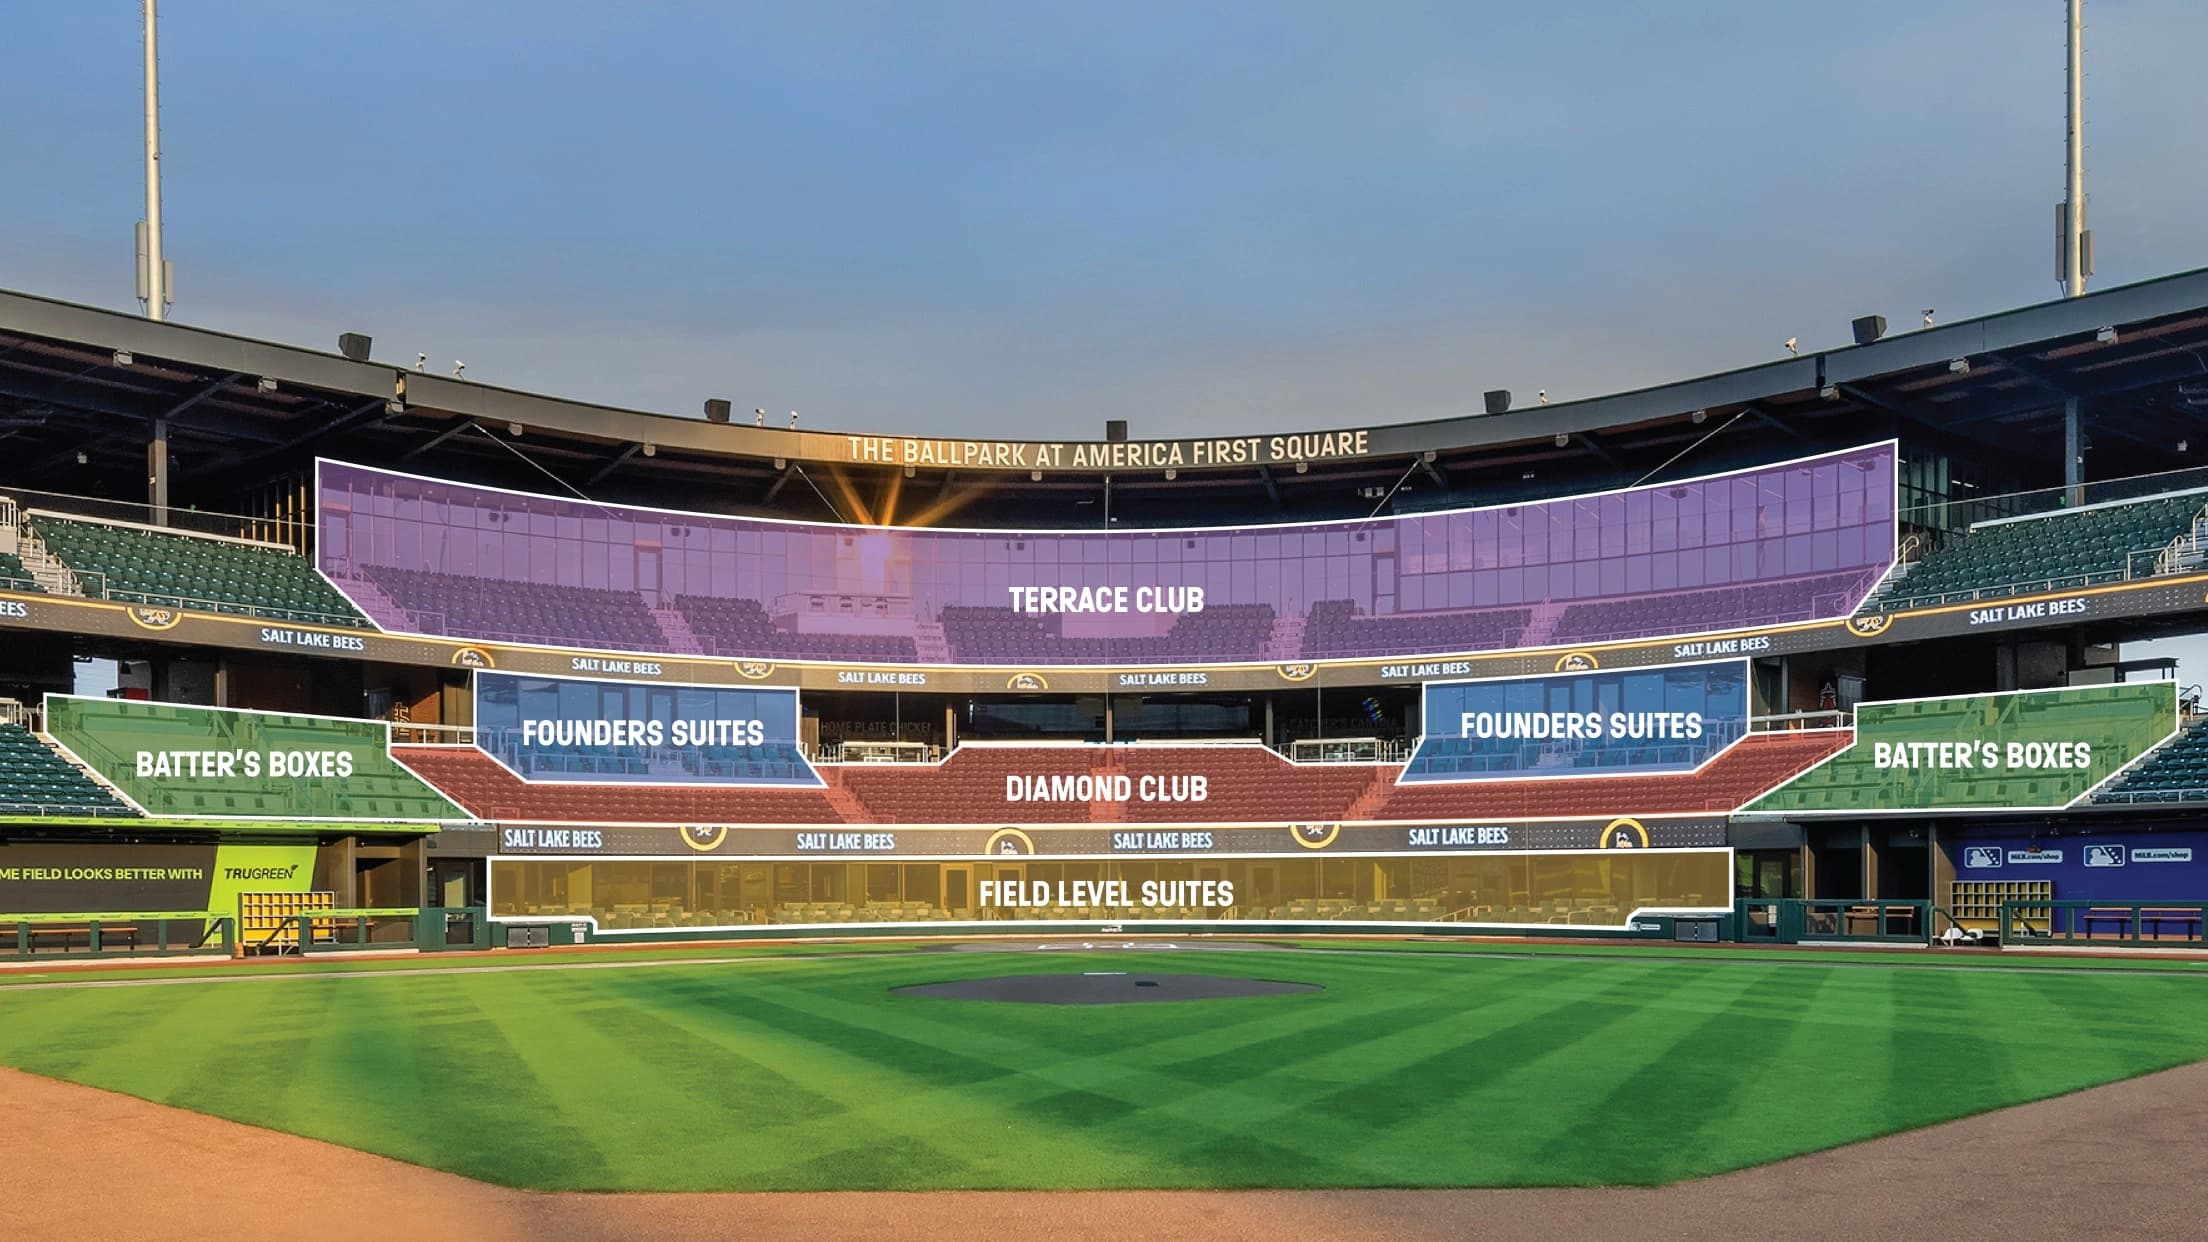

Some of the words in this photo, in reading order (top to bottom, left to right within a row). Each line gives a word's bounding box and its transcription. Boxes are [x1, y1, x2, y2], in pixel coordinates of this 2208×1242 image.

[848, 436, 893, 461] THE
[903, 439, 1027, 467] BALLPARK
[1035, 443, 1064, 467] AT
[1072, 443, 1184, 467] AMERICA
[1193, 438, 1261, 464] FIRST
[1270, 431, 1368, 461] SQUARE
[1970, 608, 2004, 625] SALT
[2008, 603, 2046, 620] LAKE
[2049, 598, 2086, 615] BEES
[261, 628, 294, 644] SALT
[297, 632, 330, 648] LAKE
[333, 636, 364, 650] BEES
[1674, 643, 1704, 657] SALT
[1706, 640, 1738, 655] LAKE
[1740, 636, 1769, 651] BEES
[572, 657, 600, 671] SALT
[603, 660, 631, 673] LAKE
[633, 662, 662, 675] BEES
[1382, 666, 1409, 678] SALT
[1412, 664, 1440, 676] LAKE
[1442, 662, 1470, 674] BEES
[838, 672, 865, 683] SALT
[868, 672, 897, 684] LAKE
[899, 673, 926, 685] BEES
[1120, 674, 1146, 685] SALT
[1149, 673, 1177, 685] LAKE
[1180, 673, 1207, 684] BEES
[855, 721, 887, 733] PLATE
[505, 829, 535, 848] SALT
[538, 829, 570, 848] LAKE
[573, 831, 602, 849] BEES
[797, 833, 827, 849] SALT
[830, 834, 861, 849] LAKE
[864, 834, 895, 850] BEES
[1114, 833, 1144, 849] SALT
[1147, 833, 1179, 848] LAKE
[1182, 832, 1213, 849] BEES
[1409, 829, 1440, 845] SALT
[1442, 828, 1475, 845] LAKE
[1477, 827, 1508, 844] BEES
[22, 868, 62, 880] FIELD
[64, 868, 113, 880] LOOKS
[115, 868, 165, 880] BETTER
[167, 868, 203, 880] WITH
[224, 867, 295, 880] TRUGREEN
